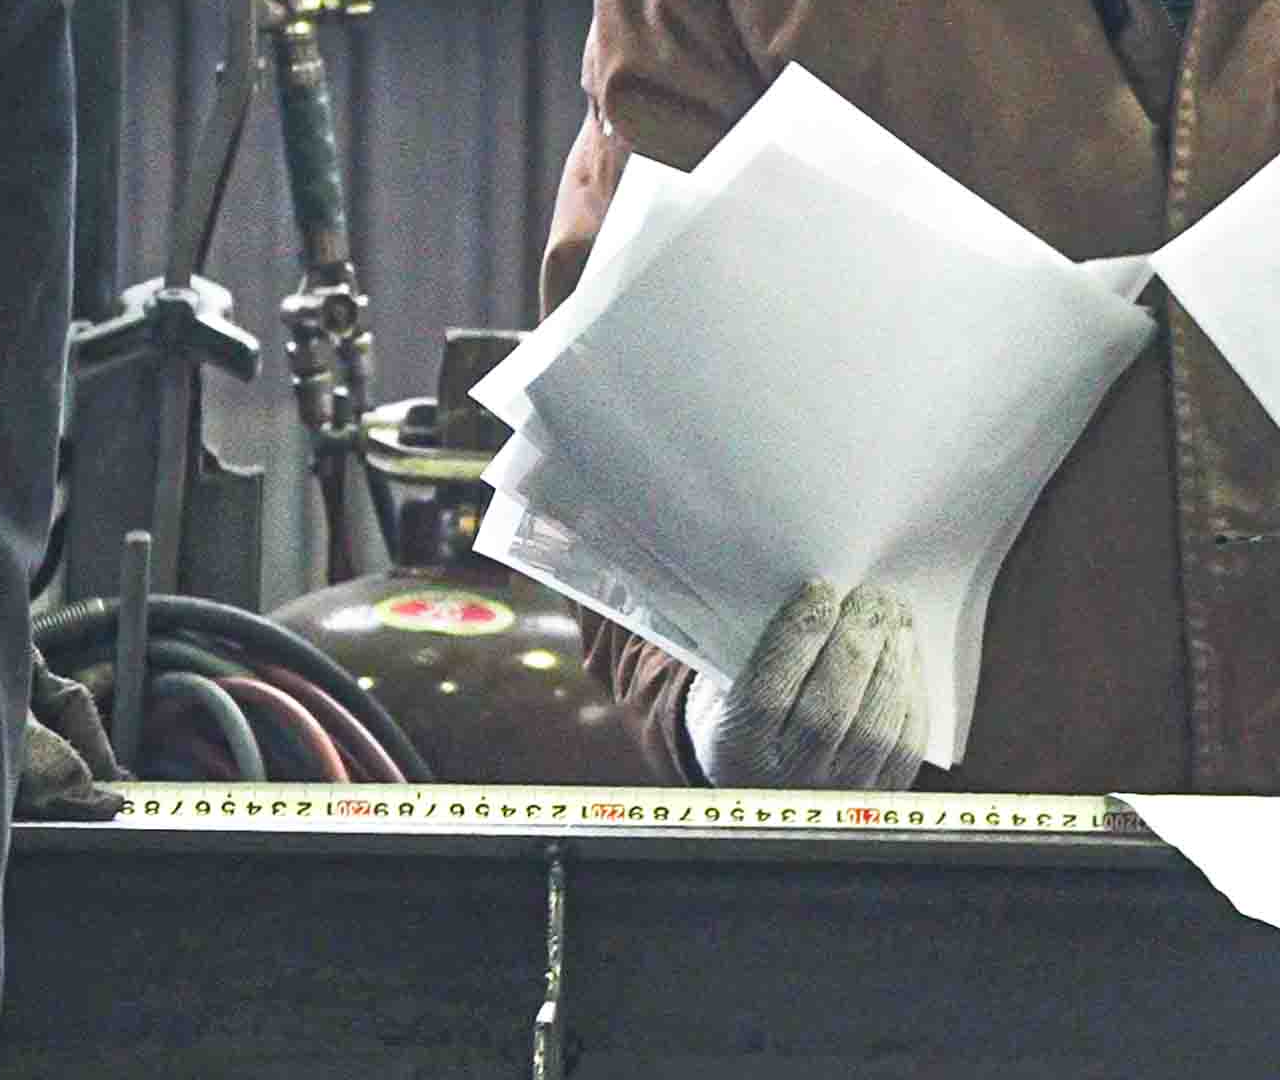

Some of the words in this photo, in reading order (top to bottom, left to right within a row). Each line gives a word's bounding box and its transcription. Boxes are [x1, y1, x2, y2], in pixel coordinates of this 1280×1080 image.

[144, 800, 161, 815] 8
[170, 800, 183, 816] 7
[194, 800, 211, 815] 6
[220, 800, 236, 816] 5
[245, 801, 263, 816] 4
[271, 800, 288, 816] 3
[296, 801, 313, 816] 2
[373, 802, 389, 817] 9
[397, 802, 415, 817] 8
[425, 803, 437, 817] 7
[449, 803, 465, 817] 6
[474, 803, 490, 817] 5
[500, 804, 517, 818] 4
[525, 804, 542, 818] 3
[551, 804, 567, 818] 2
[592, 804, 625, 819] 220
[627, 805, 644, 821] 9
[652, 806, 670, 821] 8
[679, 807, 692, 822] 7
[704, 807, 721, 822] 6
[730, 807, 745, 822] 5
[755, 808, 772, 822] 4
[780, 808, 797, 823] 3
[807, 808, 822, 823] 2
[883, 809, 900, 825] 9
[908, 810, 924, 825] 8
[935, 811, 947, 825] 7
[959, 811, 976, 826] 6
[985, 812, 1001, 827] 5
[1011, 813, 1027, 828] 4
[1036, 813, 1052, 828] 3
[1062, 814, 1078, 829] 2
